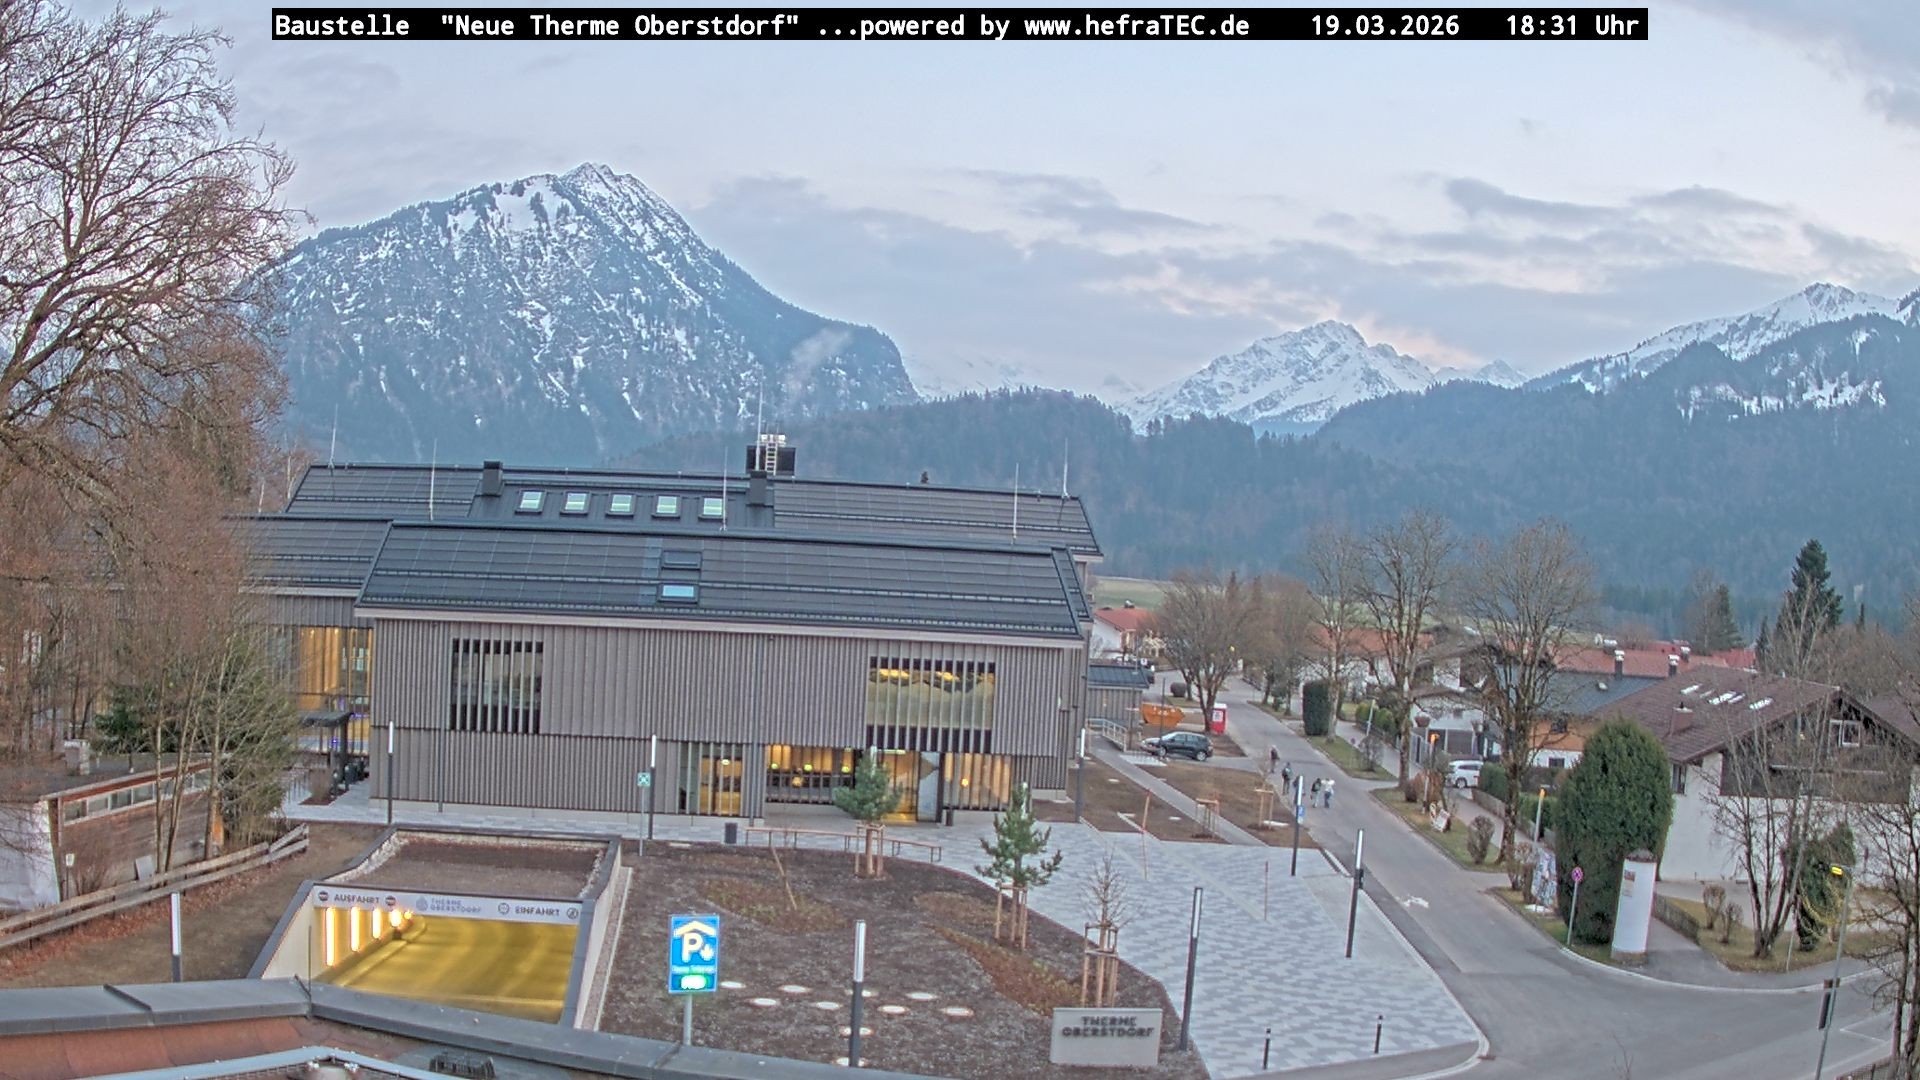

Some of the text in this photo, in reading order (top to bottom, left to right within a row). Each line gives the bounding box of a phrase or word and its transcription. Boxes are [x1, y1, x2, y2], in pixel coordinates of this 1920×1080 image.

[334, 893, 380, 904] AUSFAHRT
[515, 906, 560, 917] EINFAHRT
[681, 932, 704, 964] P
[1081, 1016, 1137, 1027] THERME
[1062, 1026, 1154, 1038] OBERSTDORF
